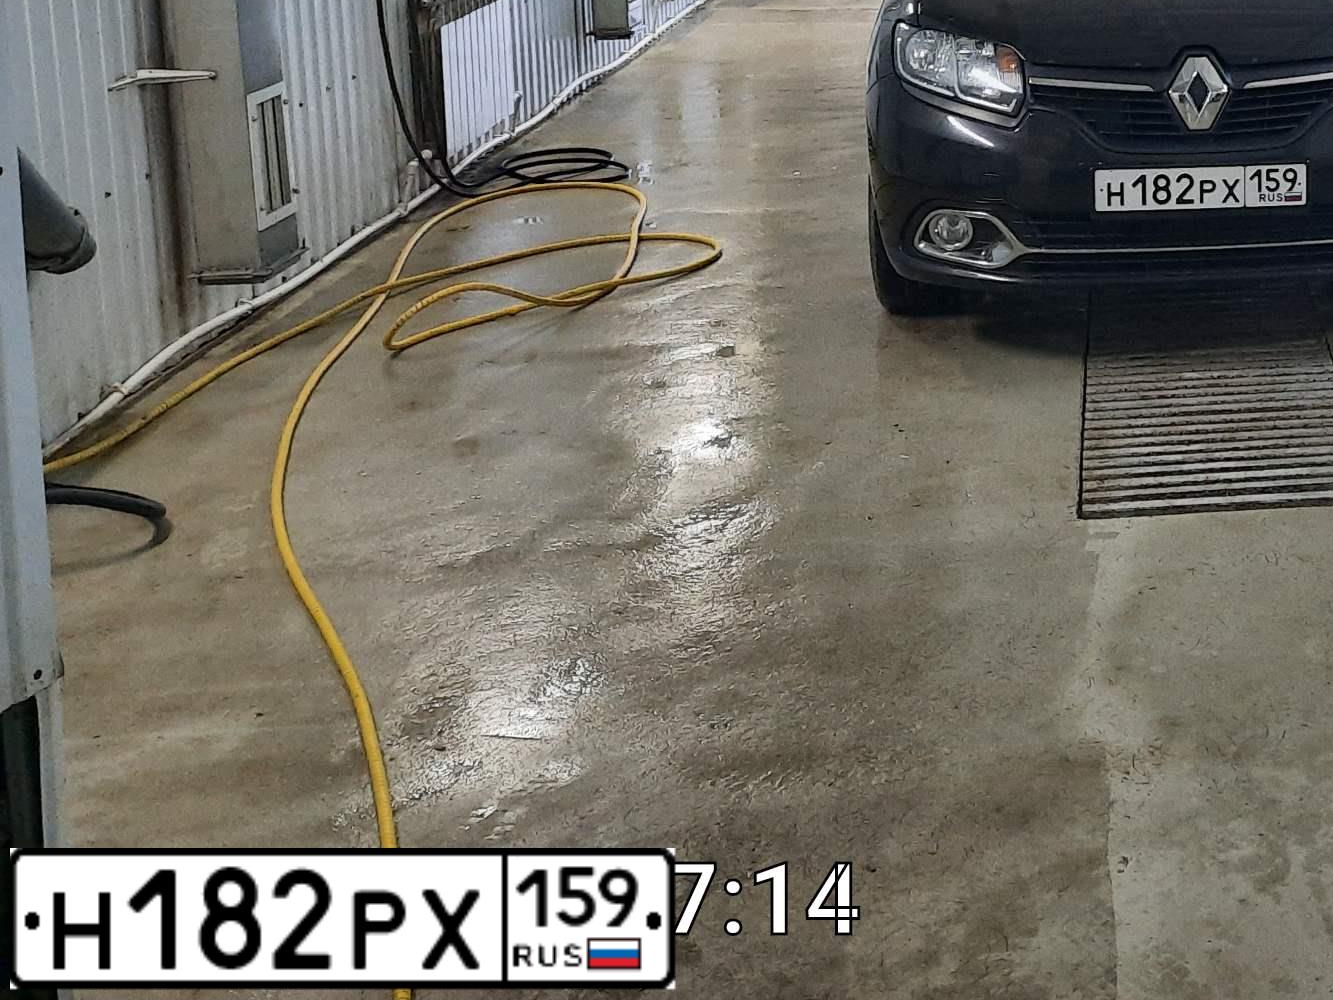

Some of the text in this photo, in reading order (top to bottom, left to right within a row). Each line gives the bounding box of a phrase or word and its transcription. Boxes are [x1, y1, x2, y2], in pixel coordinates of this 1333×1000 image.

[1106, 167, 1298, 207] Н182РХ 159
[1258, 192, 1284, 203] RUS
